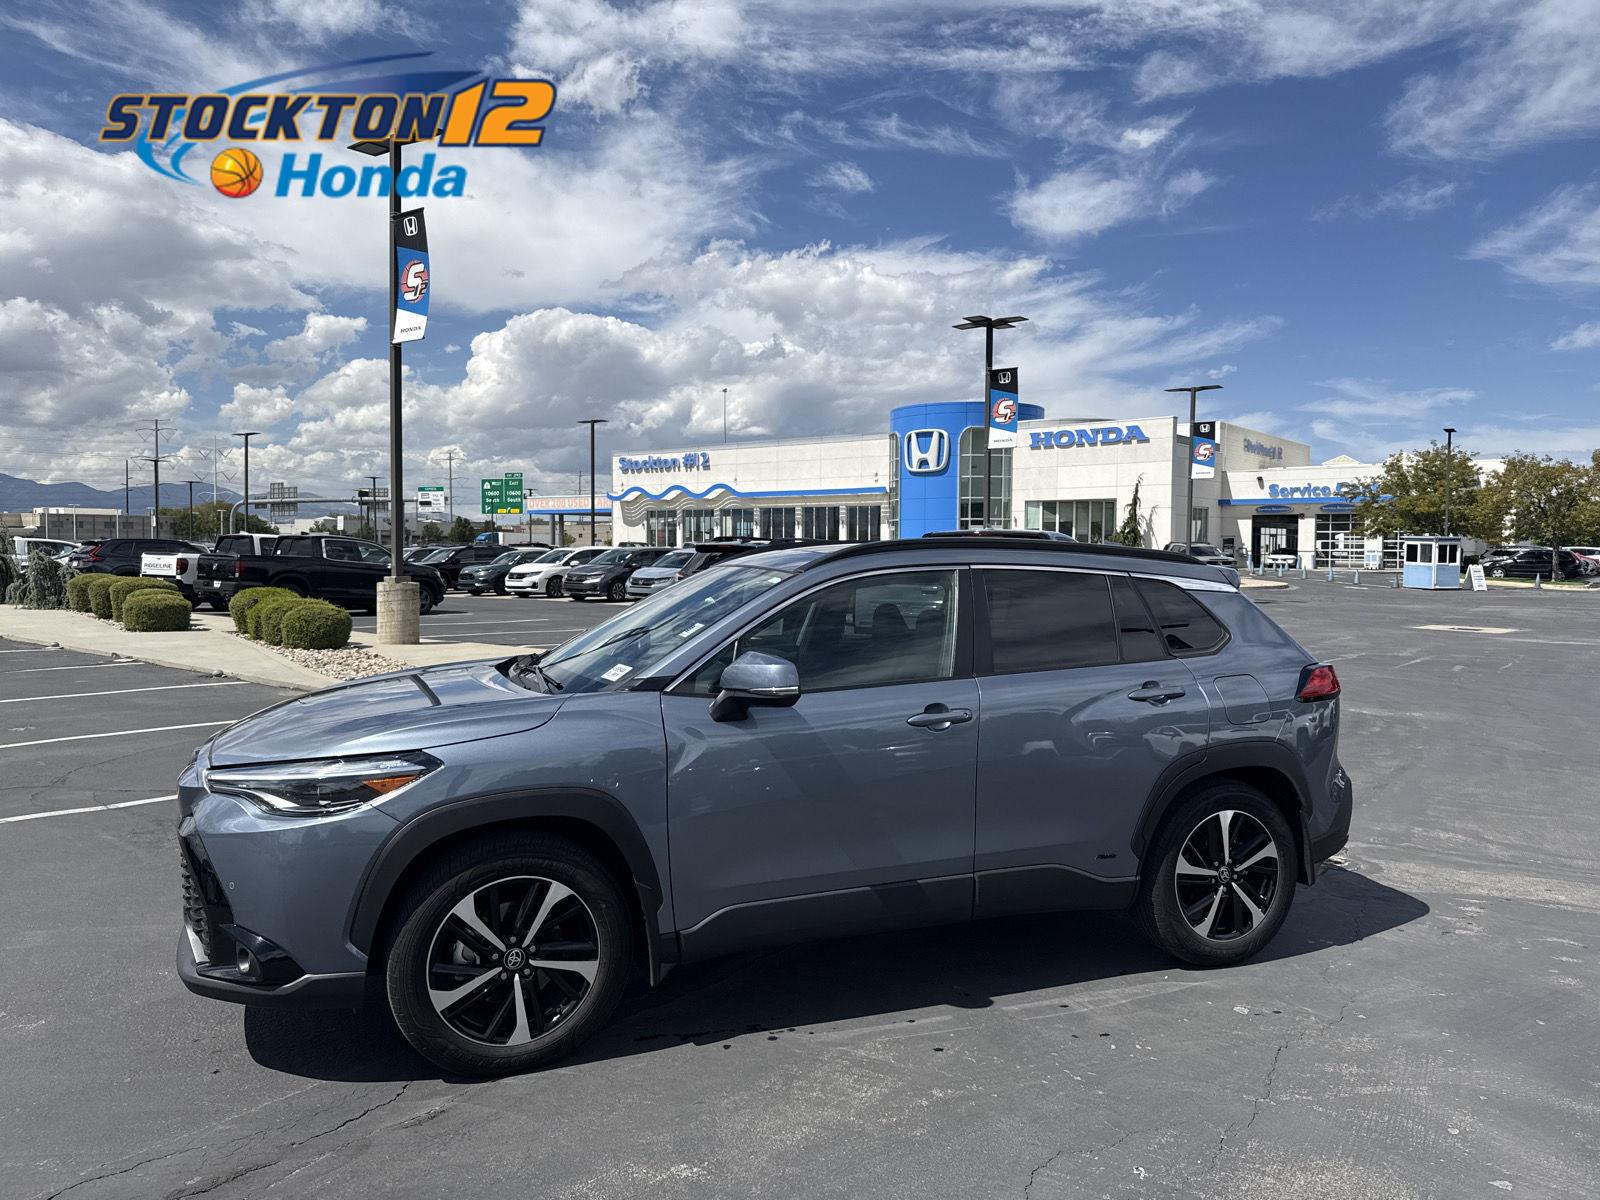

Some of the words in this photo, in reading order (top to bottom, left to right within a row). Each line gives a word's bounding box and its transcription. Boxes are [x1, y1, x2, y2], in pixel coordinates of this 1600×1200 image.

[400, 326, 422, 334] HONDA
[1029, 425, 1151, 449] HONDA
[619, 455, 681, 473] Stockton
[1268, 481, 1331, 499] Service
[529, 498, 550, 509] OVER
[551, 497, 566, 508] 200
[567, 497, 589, 508] USED
